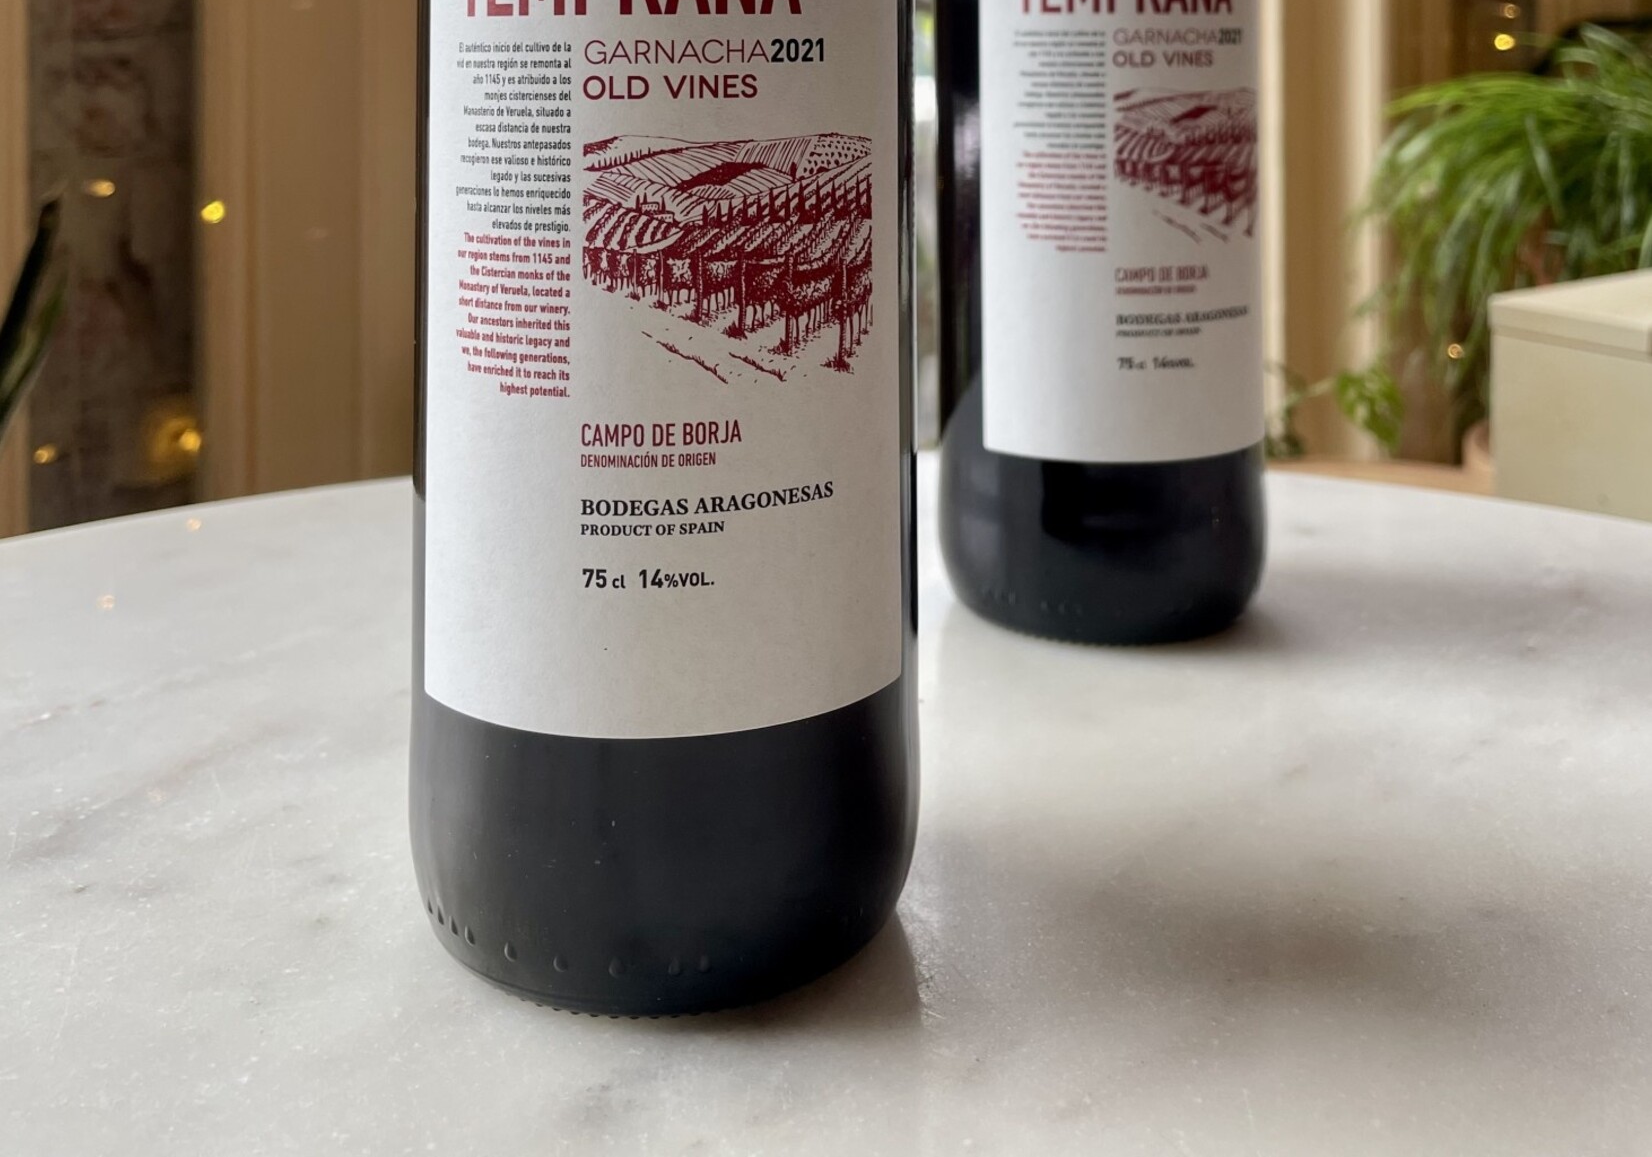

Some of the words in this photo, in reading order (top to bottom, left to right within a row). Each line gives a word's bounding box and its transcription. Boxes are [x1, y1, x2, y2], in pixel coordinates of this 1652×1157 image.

[493, 42, 510, 52] inicio
[512, 42, 523, 52] del
[525, 42, 549, 52] cultivo
[552, 42, 561, 52] de
[564, 42, 571, 51] la
[473, 59, 495, 68] nuestra
[498, 58, 518, 70] región
[530, 60, 561, 68] remonta
[564, 58, 571, 68] al
[1113, 50, 1156, 68] OLD
[1163, 50, 1213, 67] VINES
[473, 74, 483, 84] año
[485, 74, 500, 84] 1145
[502, 77, 506, 87] y
[518, 74, 550, 84] atribuido
[560, 74, 571, 84] los
[583, 75, 650, 100] OLD
[664, 74, 757, 99] VINES
[484, 90, 507, 102] monjes
[509, 91, 556, 101] cistercienses
[559, 90, 571, 101] del
[497, 106, 504, 116] de
[506, 106, 534, 118] Veruela,
[536, 107, 564, 117] situado
[566, 109, 571, 117] a
[476, 124, 495, 132] escasa
[498, 122, 528, 133] distancia
[531, 123, 539, 133] de
[542, 124, 571, 133] nuestra
[468, 137, 490, 150] bodega.
[492, 138, 521, 149] Nuestros
[523, 139, 571, 151] antepasados
[491, 156, 502, 165] ese
[504, 154, 528, 165] valioso
[531, 157, 535, 165] e
[537, 155, 571, 166] histórico
[491, 170, 512, 182] legado
[515, 174, 518, 183] y
[521, 171, 531, 182] las
[533, 172, 571, 182] sucesivas
[493, 186, 499, 197] lo
[501, 187, 524, 198] hemos
[526, 188, 571, 200] enriquecido
[467, 200, 482, 212] hasta
[484, 201, 511, 213] alcanzar
[513, 203, 523, 214] los
[526, 204, 552, 215] niveles
[554, 203, 571, 215] más
[492, 218, 521, 230] elevados
[524, 220, 532, 230] de
[535, 221, 571, 234] prestigio.
[464, 232, 474, 243] The
[476, 233, 511, 246] cultivation
[514, 236, 521, 246] of
[524, 236, 535, 247] the
[538, 238, 560, 248] vines
[563, 238, 570, 248] in
[458, 250, 466, 258] our
[468, 250, 487, 261] region
[489, 252, 509, 261] stems
[512, 252, 530, 263] from
[533, 253, 552, 264] 1145
[555, 254, 570, 264] and
[470, 265, 479, 275] the
[482, 266, 515, 278] Cistercian
[518, 270, 543, 280] monks
[546, 270, 554, 280] of
[557, 271, 570, 281] the
[459, 279, 489, 295] Monastery
[492, 283, 498, 293] of
[500, 284, 530, 297] Veruela,
[532, 286, 562, 297] located
[565, 289, 570, 297] a
[459, 295, 473, 307] short
[475, 298, 502, 310] distance
[505, 301, 522, 311] from
[524, 304, 537, 312] our
[540, 303, 570, 316] winery.
[468, 313, 478, 323] Our
[480, 315, 513, 327] ancestors
[516, 318, 551, 329] inherited
[554, 320, 570, 330] this
[456, 328, 480, 340] valuable
[482, 331, 493, 341] and
[496, 332, 523, 345] historic
[526, 335, 552, 349] legacy
[555, 337, 570, 347] and
[461, 346, 471, 356] we,
[473, 346, 482, 356] the
[485, 347, 517, 363] following
[519, 353, 570, 365] generations,
[468, 362, 481, 372] have
[484, 365, 513, 377] enriched
[516, 367, 521, 377] it
[523, 368, 531, 378] to
[534, 369, 556, 380] reach
[559, 369, 570, 381] its
[500, 382, 527, 396] highest
[530, 384, 570, 397] potential.
[581, 423, 644, 447] CAMPO
[652, 423, 676, 447] DE
[683, 420, 742, 445] BORJA
[581, 452, 657, 468] DENOMINACIÓN
[661, 454, 675, 467] DE
[678, 452, 716, 466] ORIGEN
[581, 498, 688, 516] BODEGAS
[694, 481, 834, 514] ARAGONESAS
[581, 524, 652, 536] PRODUCT
[656, 525, 675, 535] OF
[680, 521, 725, 534] SPAIN
[582, 569, 607, 588] 75
[612, 575, 625, 588] cl
[639, 569, 715, 588] 14%VOL.
